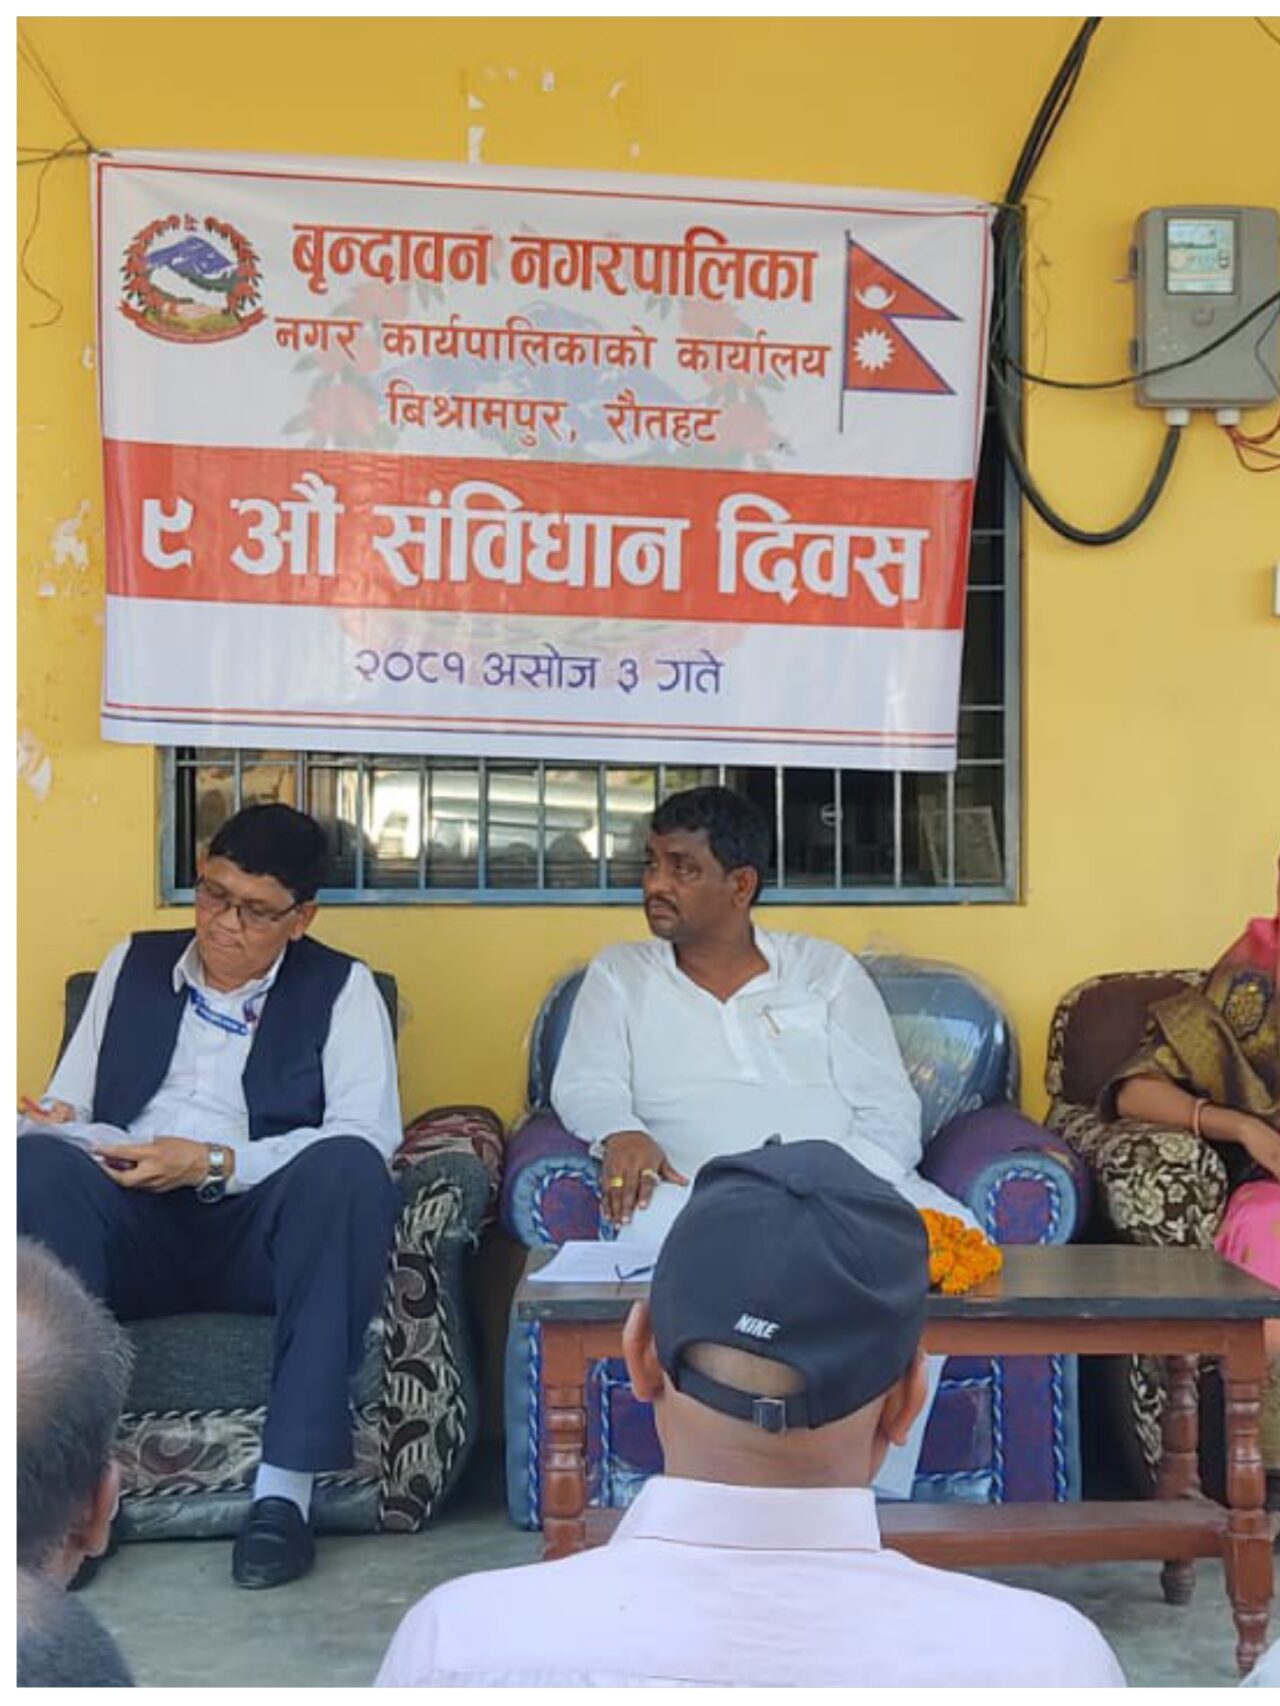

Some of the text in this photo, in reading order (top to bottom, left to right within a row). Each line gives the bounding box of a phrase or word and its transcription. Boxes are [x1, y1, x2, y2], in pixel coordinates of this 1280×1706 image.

[292, 223, 819, 303] बृन्दावन नगरपालिका
[275, 313, 832, 380] नगर कार्यपालिकाको कार्यालय
[384, 379, 723, 446] बिश्रामपुर, रौतहट
[141, 497, 194, 570] ९
[371, 479, 691, 593] संविधान
[716, 491, 931, 608] दिवस
[354, 641, 725, 695] २०८१ असोज ३ गते
[734, 1313, 781, 1339] NIKE
